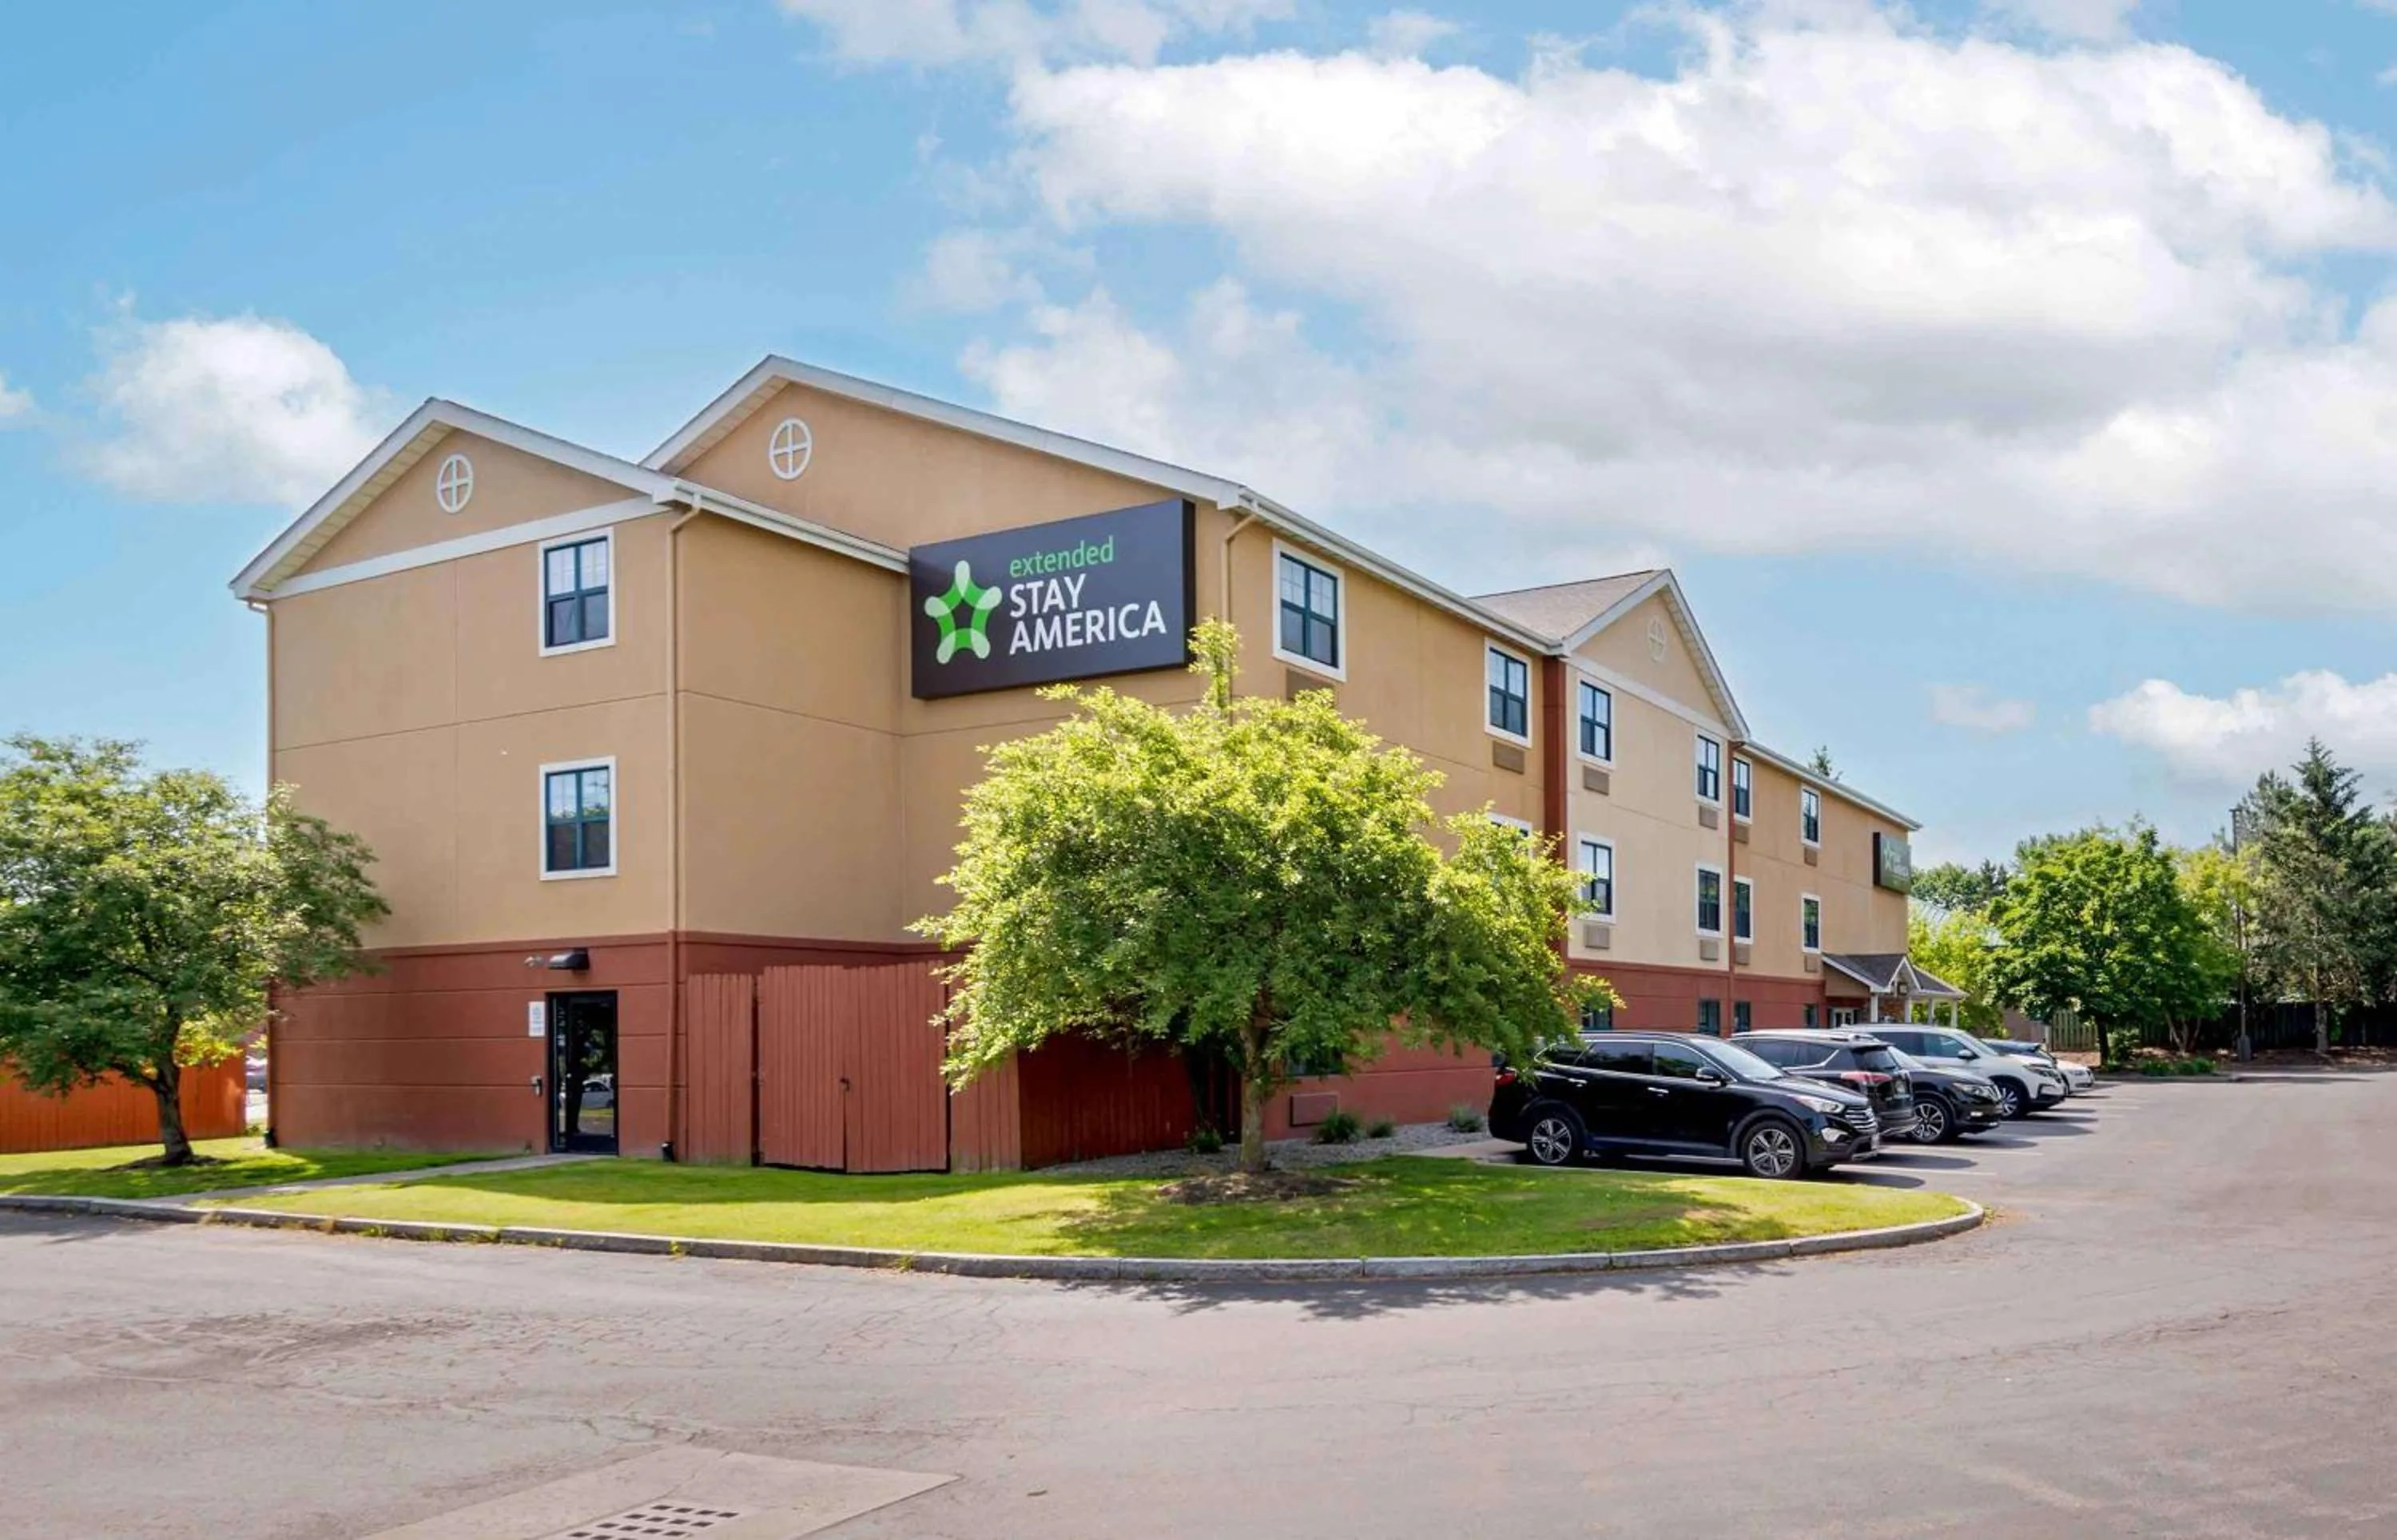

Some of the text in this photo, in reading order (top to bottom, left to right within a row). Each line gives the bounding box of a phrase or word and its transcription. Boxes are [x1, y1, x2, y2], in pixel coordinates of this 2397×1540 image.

[1009, 535, 1114, 578] extended
[1009, 574, 1087, 617] STAY
[1009, 600, 1167, 655] AMERICA
